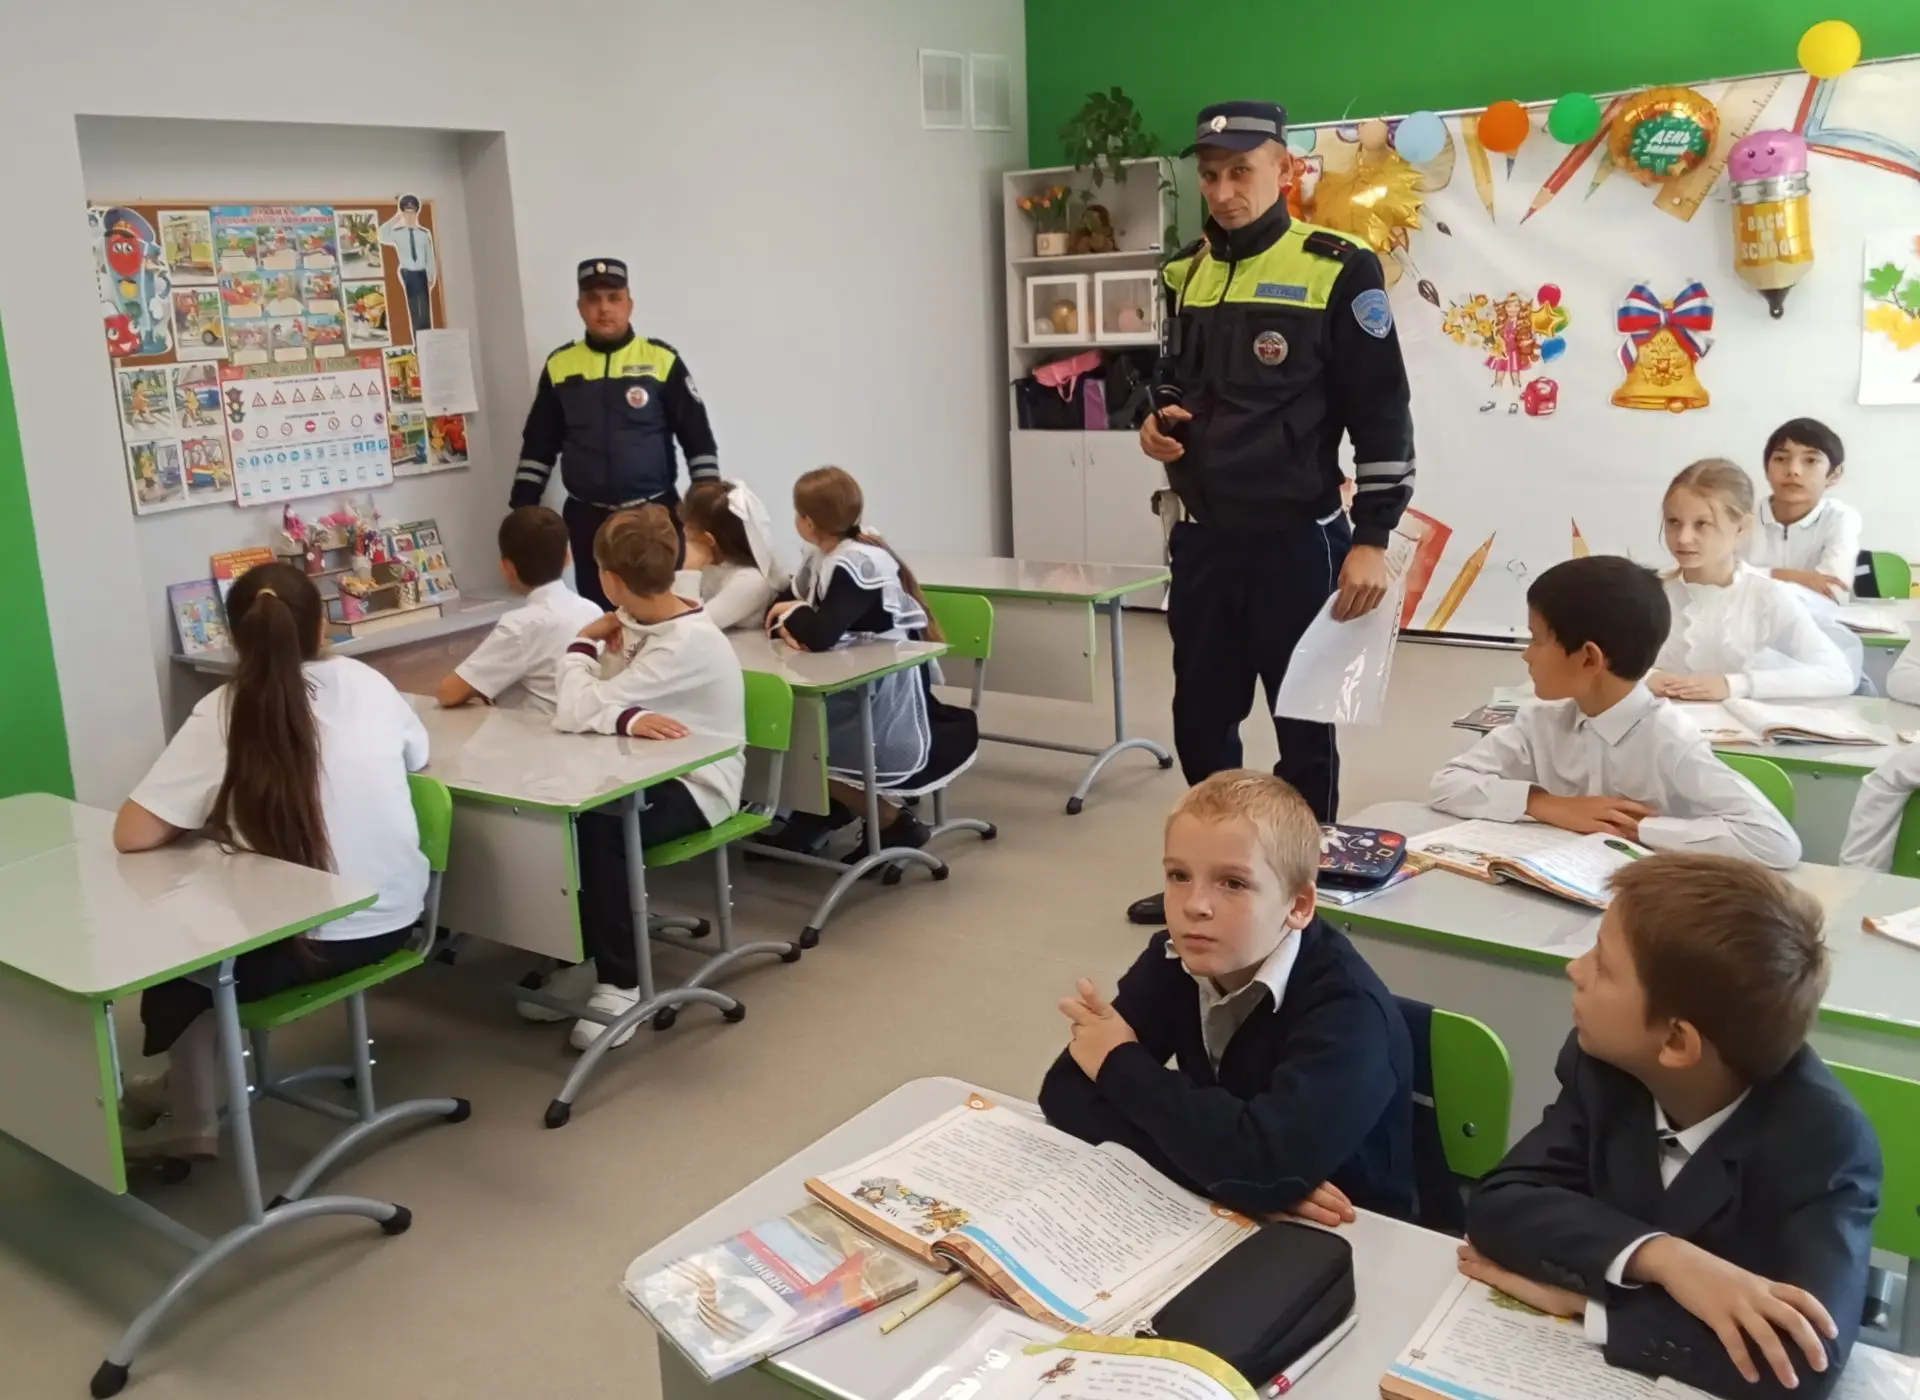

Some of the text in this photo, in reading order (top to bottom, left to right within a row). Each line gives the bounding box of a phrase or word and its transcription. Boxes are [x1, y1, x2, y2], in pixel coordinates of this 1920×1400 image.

[1649, 129, 1692, 145] ДЕНЬ
[1747, 212, 1786, 232] BACK
[743, 1253, 796, 1296] ДНЕВНИК
